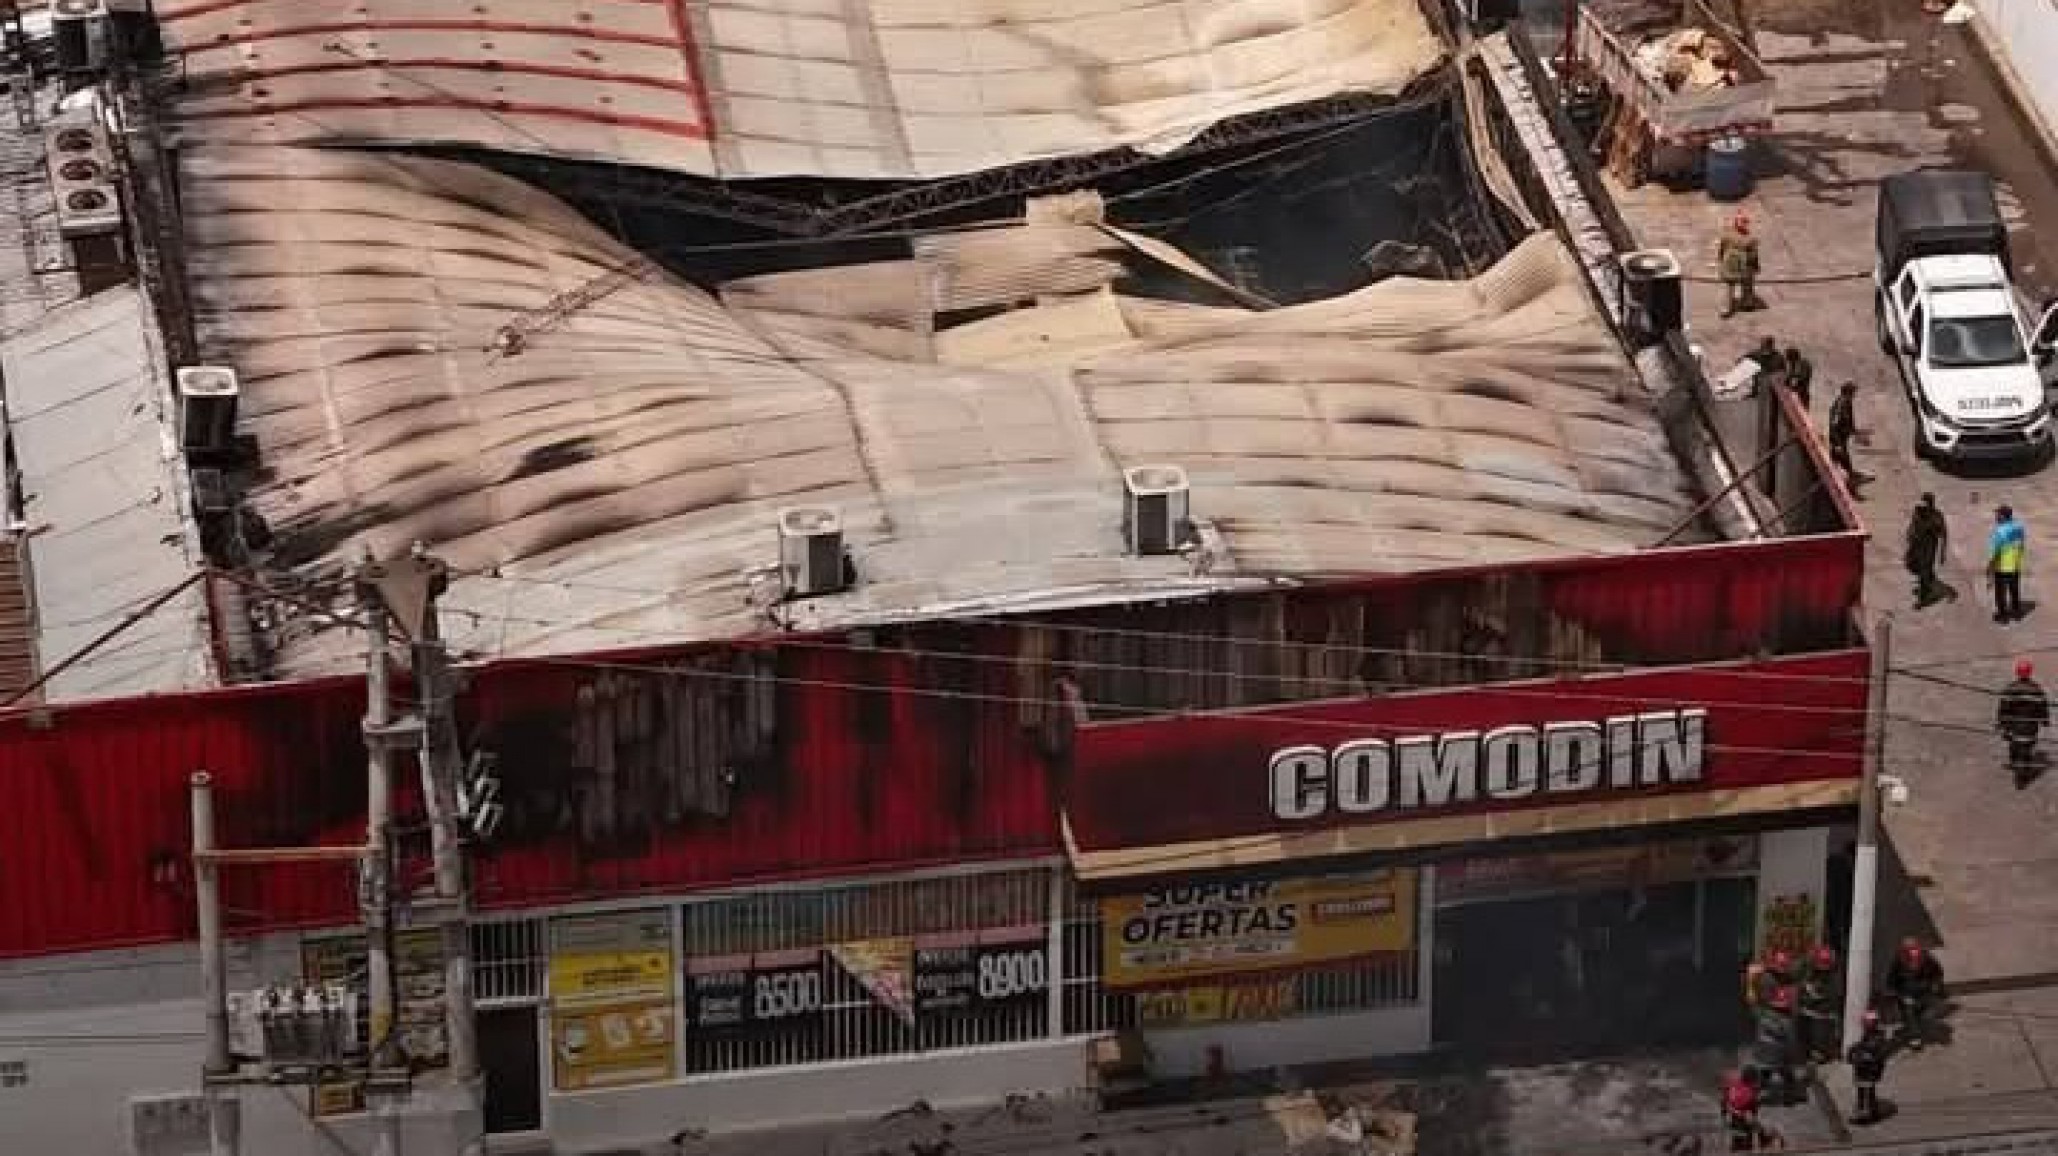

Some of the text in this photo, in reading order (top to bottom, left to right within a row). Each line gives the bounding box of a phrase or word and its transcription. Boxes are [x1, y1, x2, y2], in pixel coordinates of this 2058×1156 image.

[1269, 708, 1706, 820] COMODIN
[1122, 904, 1296, 942] OFERTAS
[979, 949, 1044, 998] 8900
